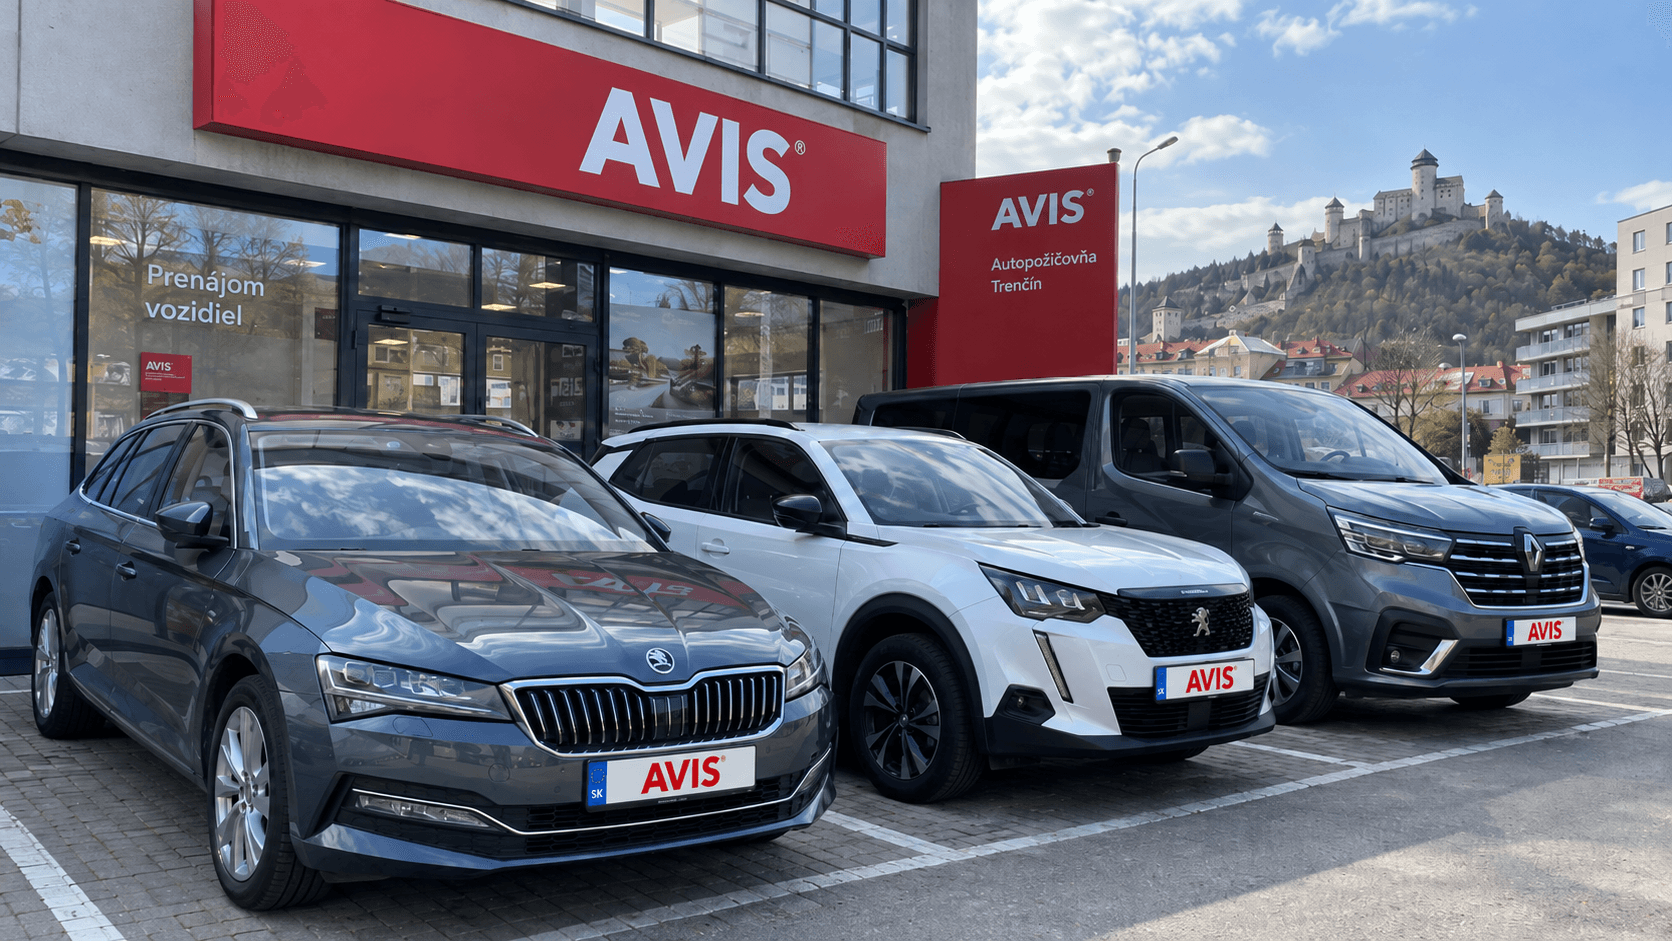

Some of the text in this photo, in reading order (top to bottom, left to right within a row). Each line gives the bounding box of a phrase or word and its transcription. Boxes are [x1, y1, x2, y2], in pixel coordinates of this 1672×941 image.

[991, 249, 1097, 272] Autopožičovňa
[147, 263, 264, 298] Prenájom
[991, 276, 1042, 293] Trenčín
[144, 300, 242, 326] vozidiel
[145, 360, 172, 371] AVIS
[591, 789, 603, 799] SK
